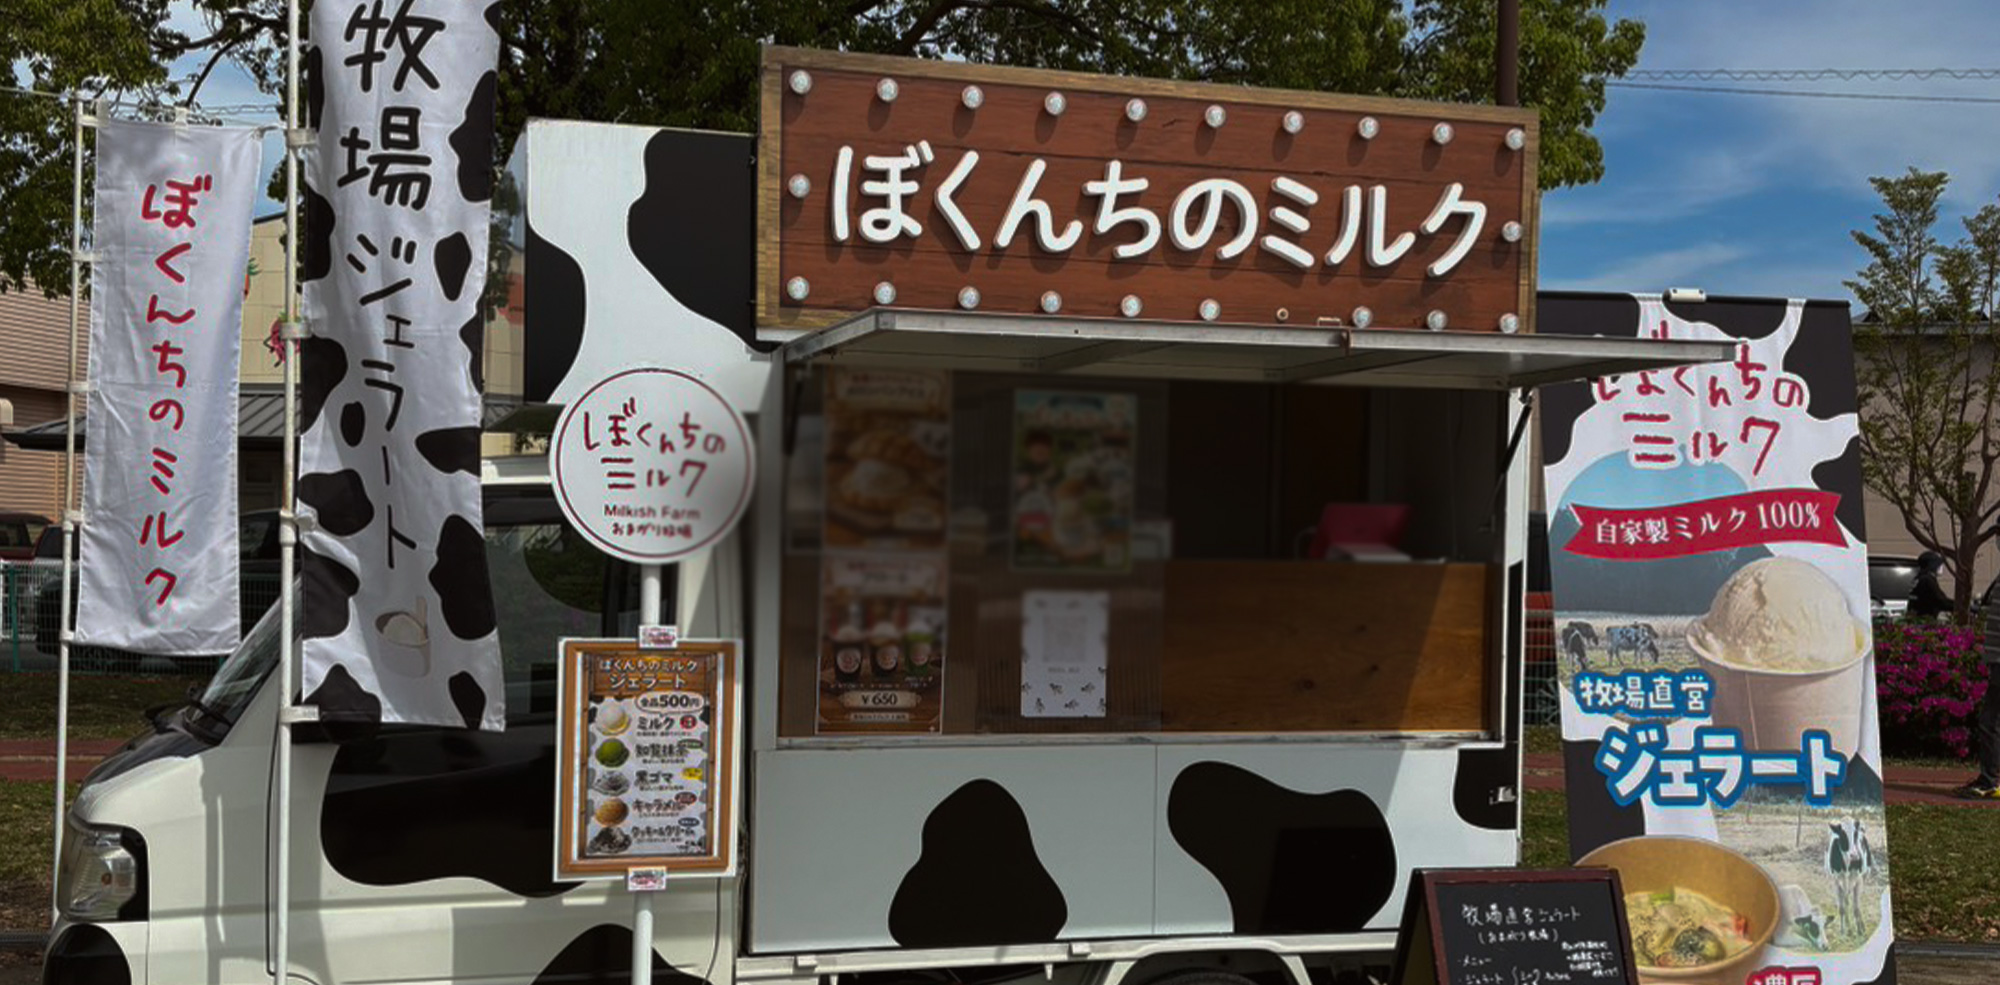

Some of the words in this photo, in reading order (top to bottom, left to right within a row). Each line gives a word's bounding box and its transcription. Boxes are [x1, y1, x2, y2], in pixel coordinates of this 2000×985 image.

[832, 139, 1488, 277] ぼくんちのミルク
[337, 0, 447, 570] 牧場ジェラート
[140, 173, 212, 607] ぼくんちのミルク
[583, 396, 727, 455] ぼくんちの
[1622, 412, 1780, 477] ミルク
[600, 457, 708, 499] ミルク
[603, 503, 658, 519] Milkish
[660, 504, 702, 520] Farm
[1757, 500, 1821, 530] 100%
[599, 657, 698, 672] ぼくんちのミルク
[609, 672, 687, 690] ジェラート
[1579, 674, 1710, 711] 牧場直営
[636, 716, 676, 731] ミルク
[634, 770, 674, 786] 黒ゴマ
[1601, 727, 1842, 798] ジェラート
[632, 798, 686, 812] キャラメル
